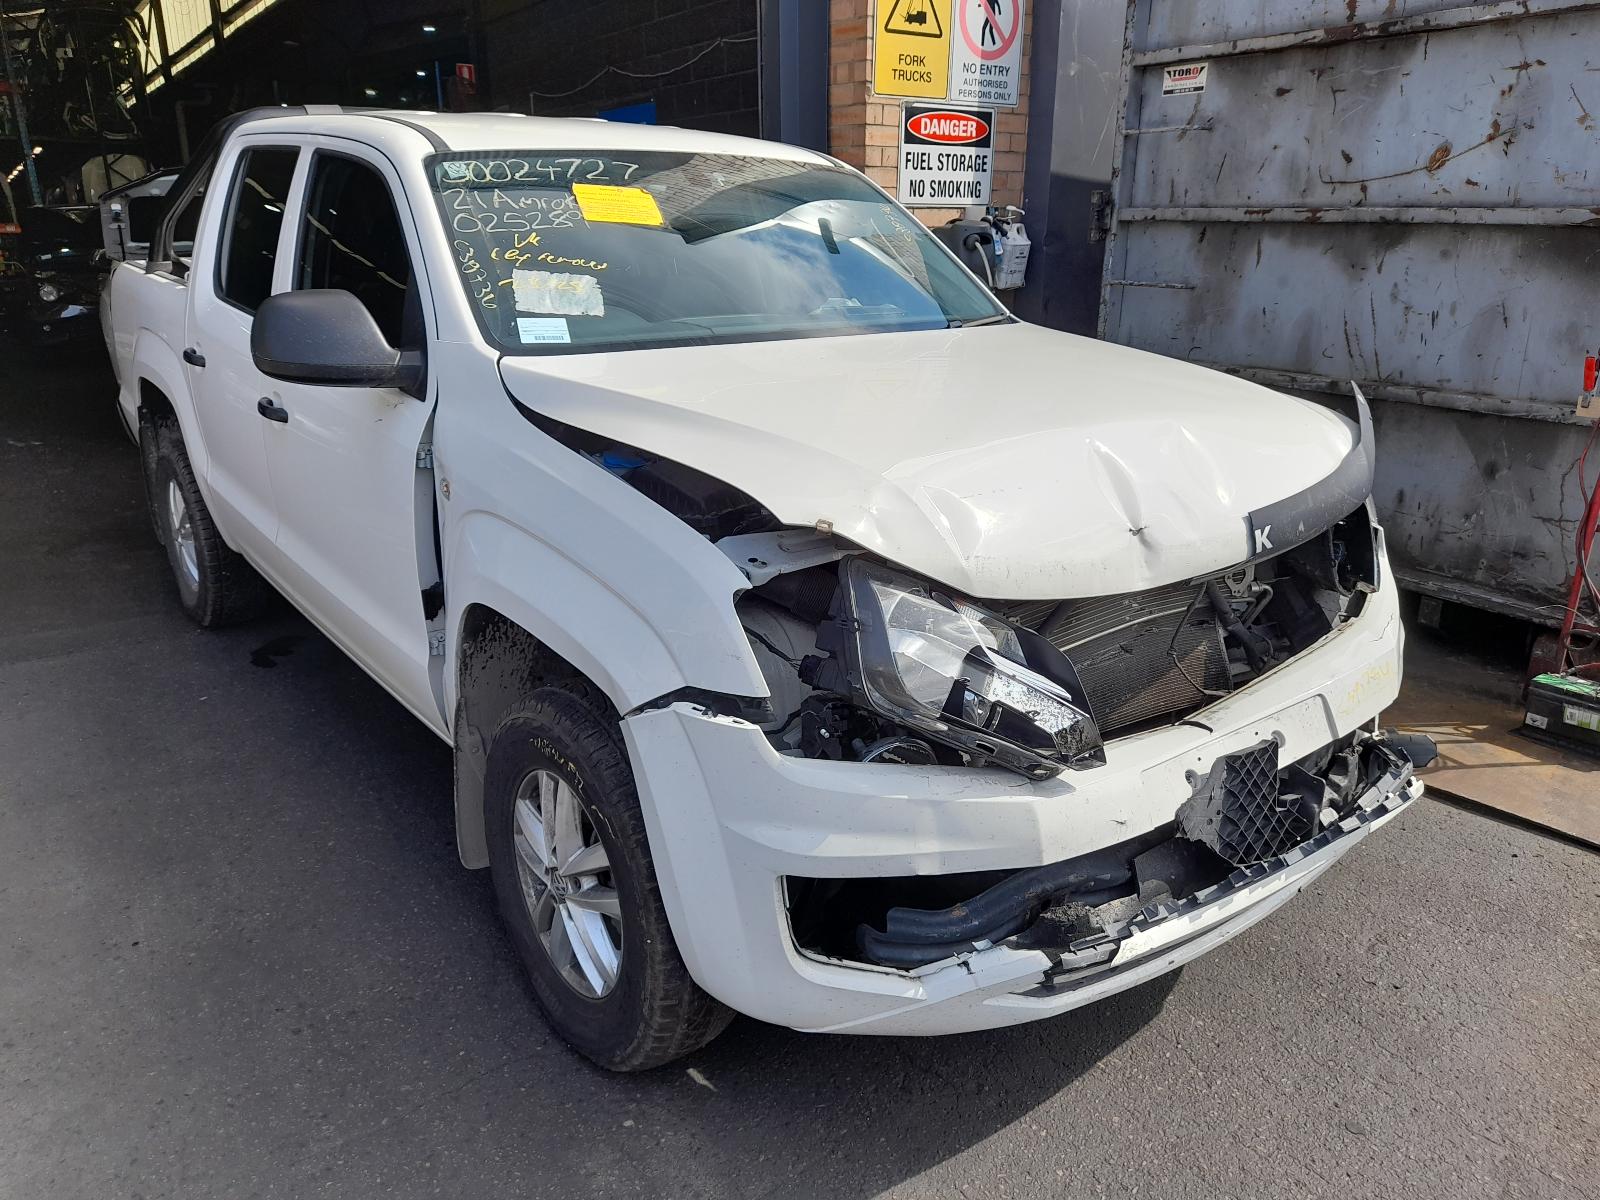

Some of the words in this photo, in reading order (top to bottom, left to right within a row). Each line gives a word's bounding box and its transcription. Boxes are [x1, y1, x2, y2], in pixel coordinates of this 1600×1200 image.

[898, 53, 927, 67] FORK
[891, 68, 932, 83] TRUCKS
[962, 62, 977, 75] NO
[979, 63, 1011, 77] ENTRY
[1172, 66, 1200, 78] TORO
[962, 77, 1009, 89] AUTHORISED
[958, 88, 992, 100] PERSONS
[993, 91, 1012, 101] ONLY
[920, 117, 977, 138] DANGER
[905, 151, 934, 171] FUEL
[937, 152, 988, 173] STORAGE
[909, 179, 926, 198] NO
[929, 179, 982, 199] SMOKING
[1254, 525, 1274, 554] K
